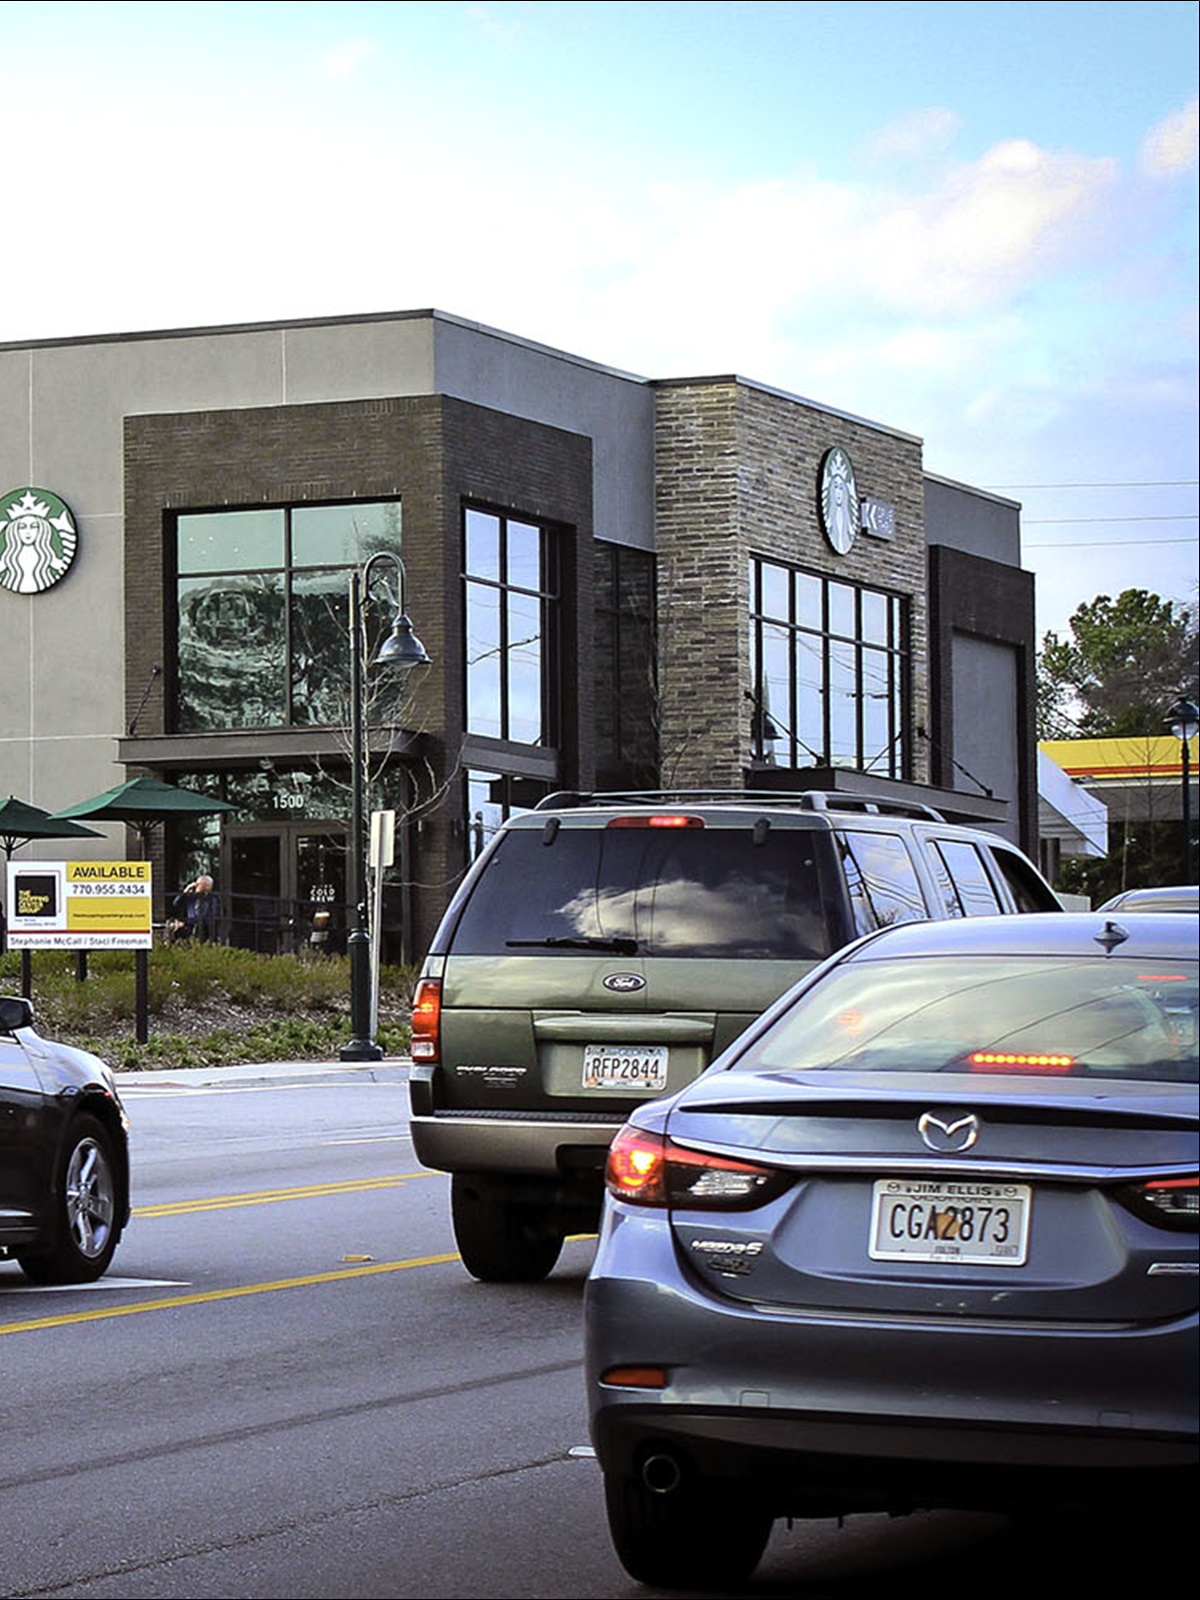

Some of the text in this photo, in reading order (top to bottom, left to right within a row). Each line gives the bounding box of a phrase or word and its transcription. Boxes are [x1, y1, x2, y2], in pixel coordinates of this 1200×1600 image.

[273, 794, 304, 809] 1500
[72, 866, 145, 878] AVAILABLE
[72, 884, 146, 895] 770.955.2434
[10, 937, 52, 946] Stephanie
[53, 937, 83, 946] McCall
[591, 1057, 660, 1079] RFP2844
[912, 1183, 992, 1197] JIM ELLIS
[890, 1203, 1010, 1243] CGA2873
